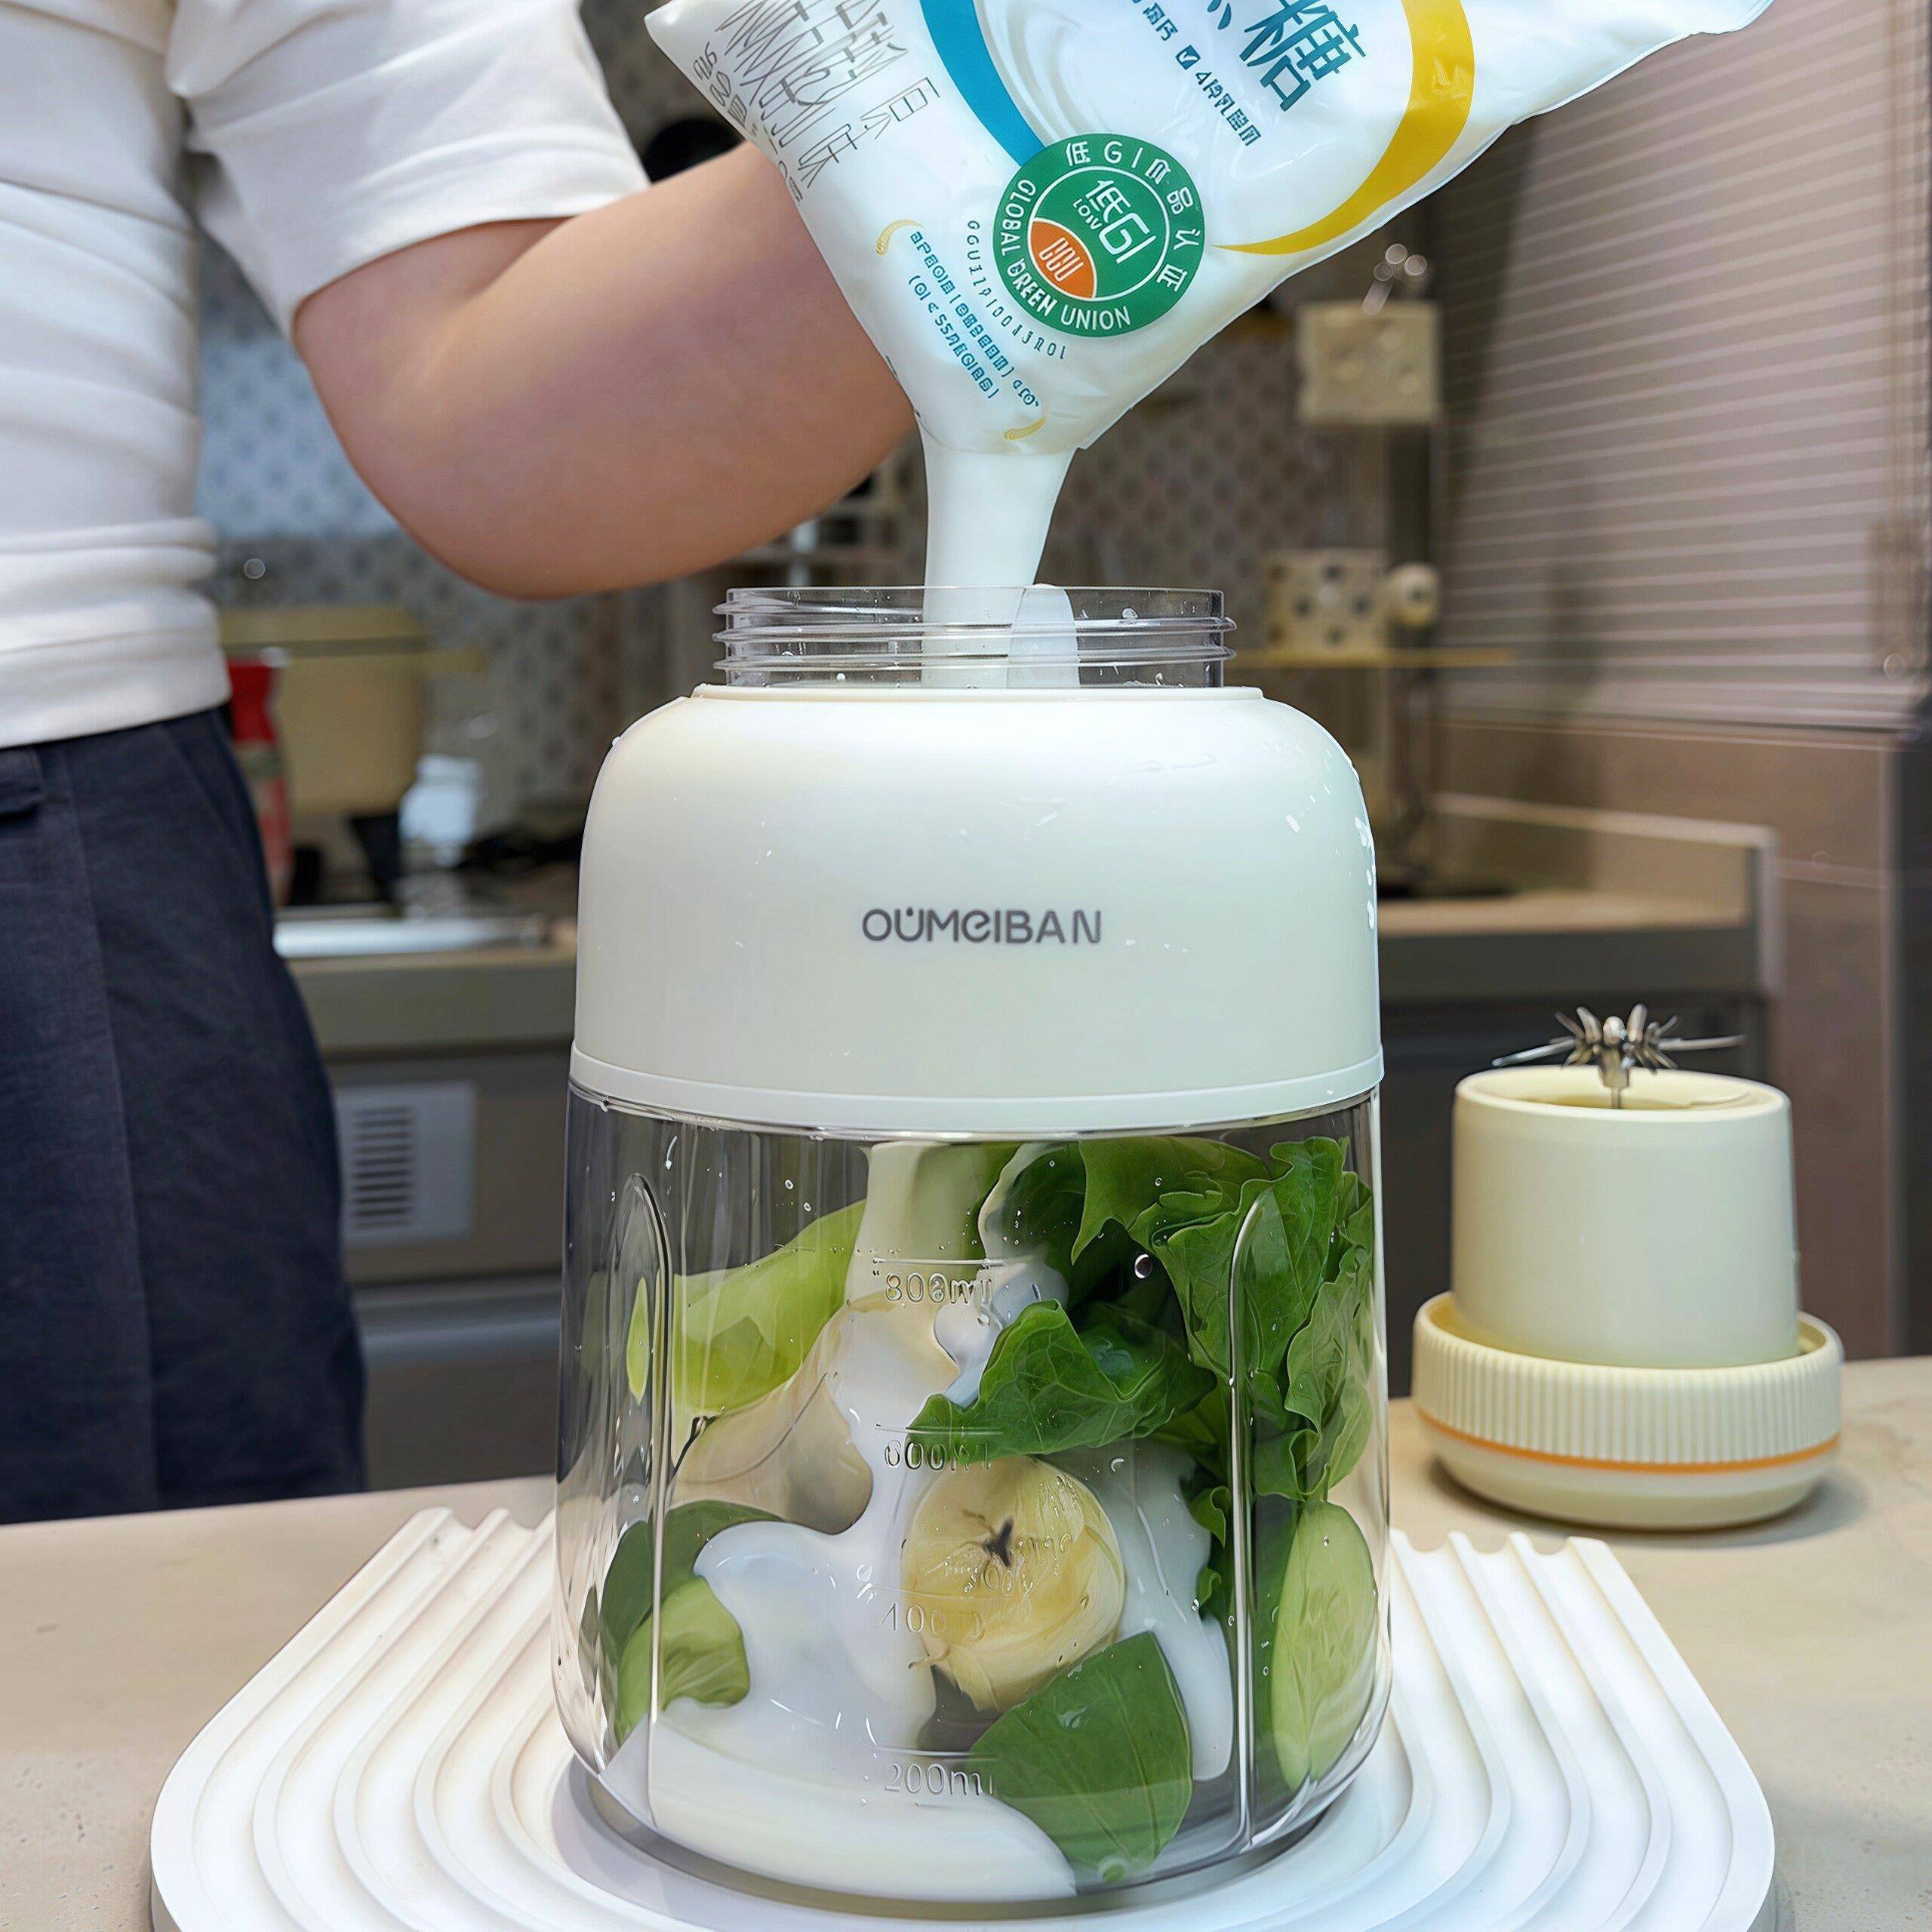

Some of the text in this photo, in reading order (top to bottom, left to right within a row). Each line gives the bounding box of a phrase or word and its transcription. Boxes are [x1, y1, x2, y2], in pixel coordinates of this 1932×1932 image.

[1206, 0, 1367, 112] 糖
[1000, 179, 1036, 257] GLOBAL
[1060, 305, 1131, 331] UNION
